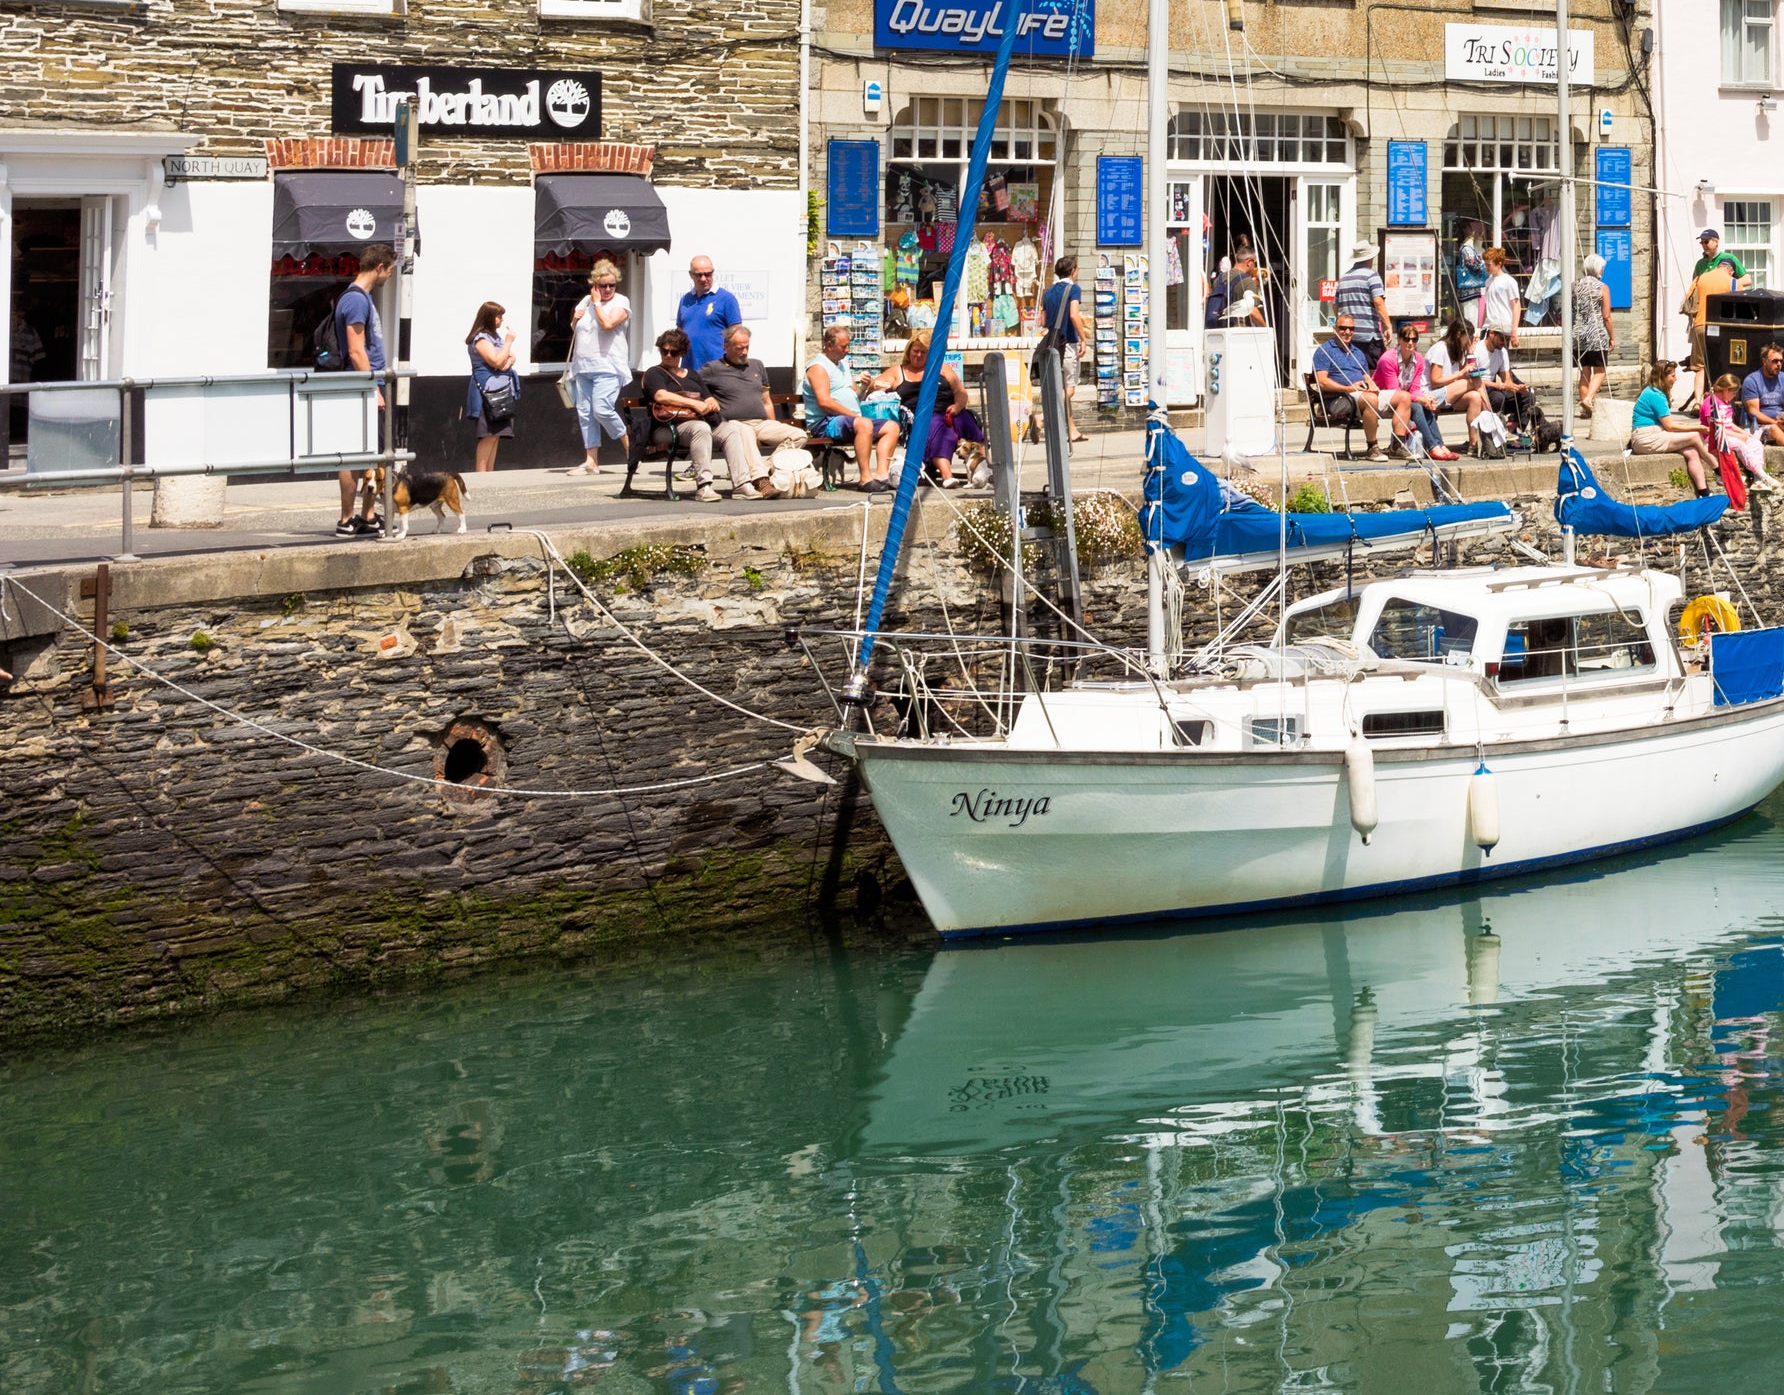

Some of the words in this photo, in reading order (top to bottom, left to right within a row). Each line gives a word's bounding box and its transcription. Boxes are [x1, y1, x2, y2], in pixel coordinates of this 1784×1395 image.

[1500, 40, 1579, 72] SOCIEY
[1484, 68, 1506, 77] Ladies
[170, 160, 220, 173] NORTH
[224, 161, 261, 174] QUAY
[949, 788, 1051, 827] Ninya
